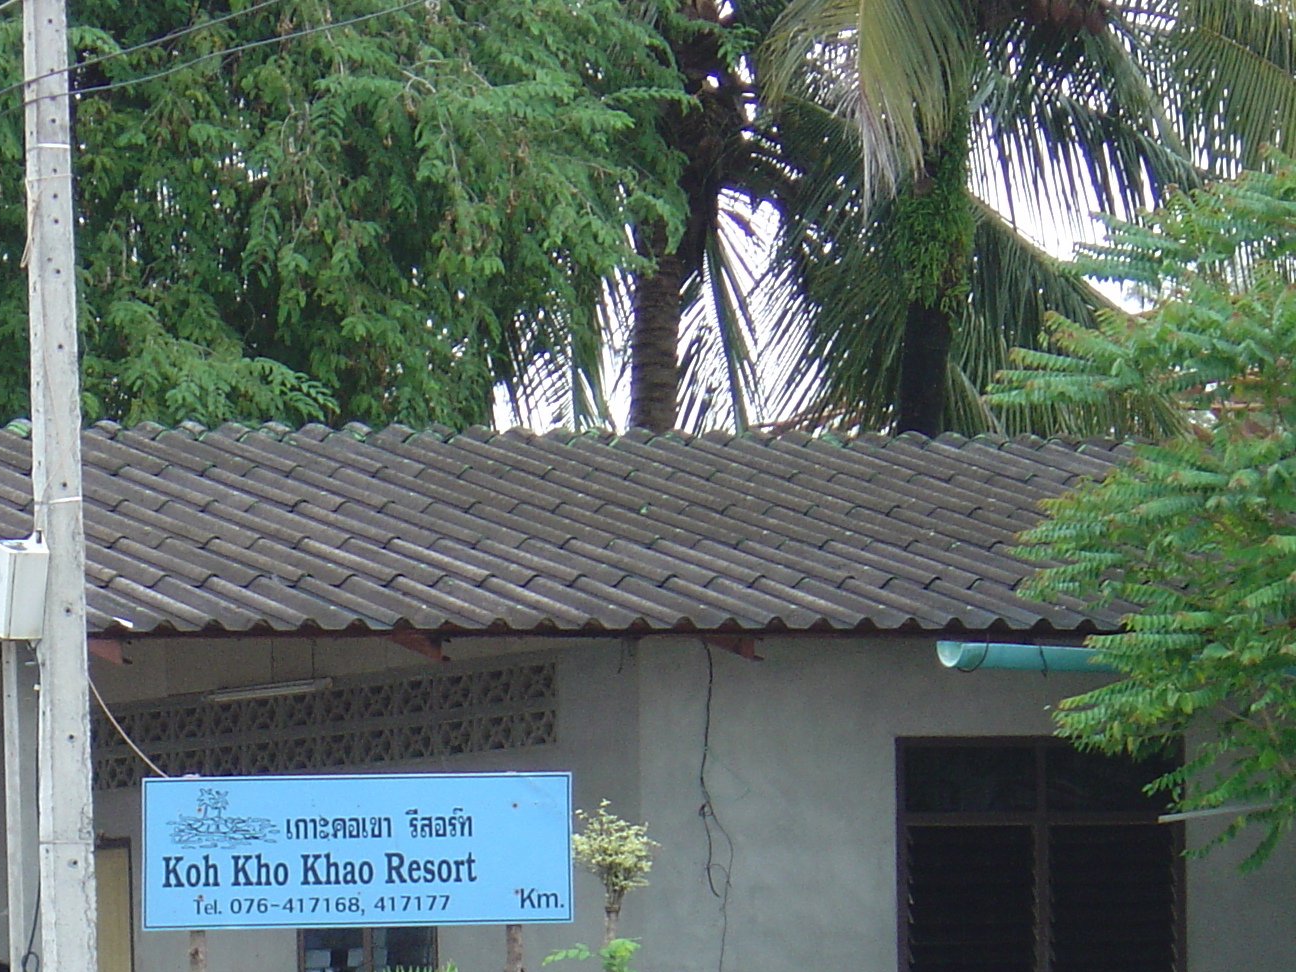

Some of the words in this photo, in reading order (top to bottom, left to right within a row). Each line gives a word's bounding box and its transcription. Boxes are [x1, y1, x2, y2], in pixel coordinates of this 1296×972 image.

[285, 814, 393, 840] เกาะคอเขา
[405, 807, 474, 839] รีสอร์ท
[162, 854, 220, 889] Koh
[231, 853, 289, 887] Kho
[301, 851, 375, 886] Khao
[384, 850, 478, 884] Resort
[194, 898, 223, 915] Tel.
[373, 895, 451, 912] 417177
[520, 888, 565, 909] Km.
